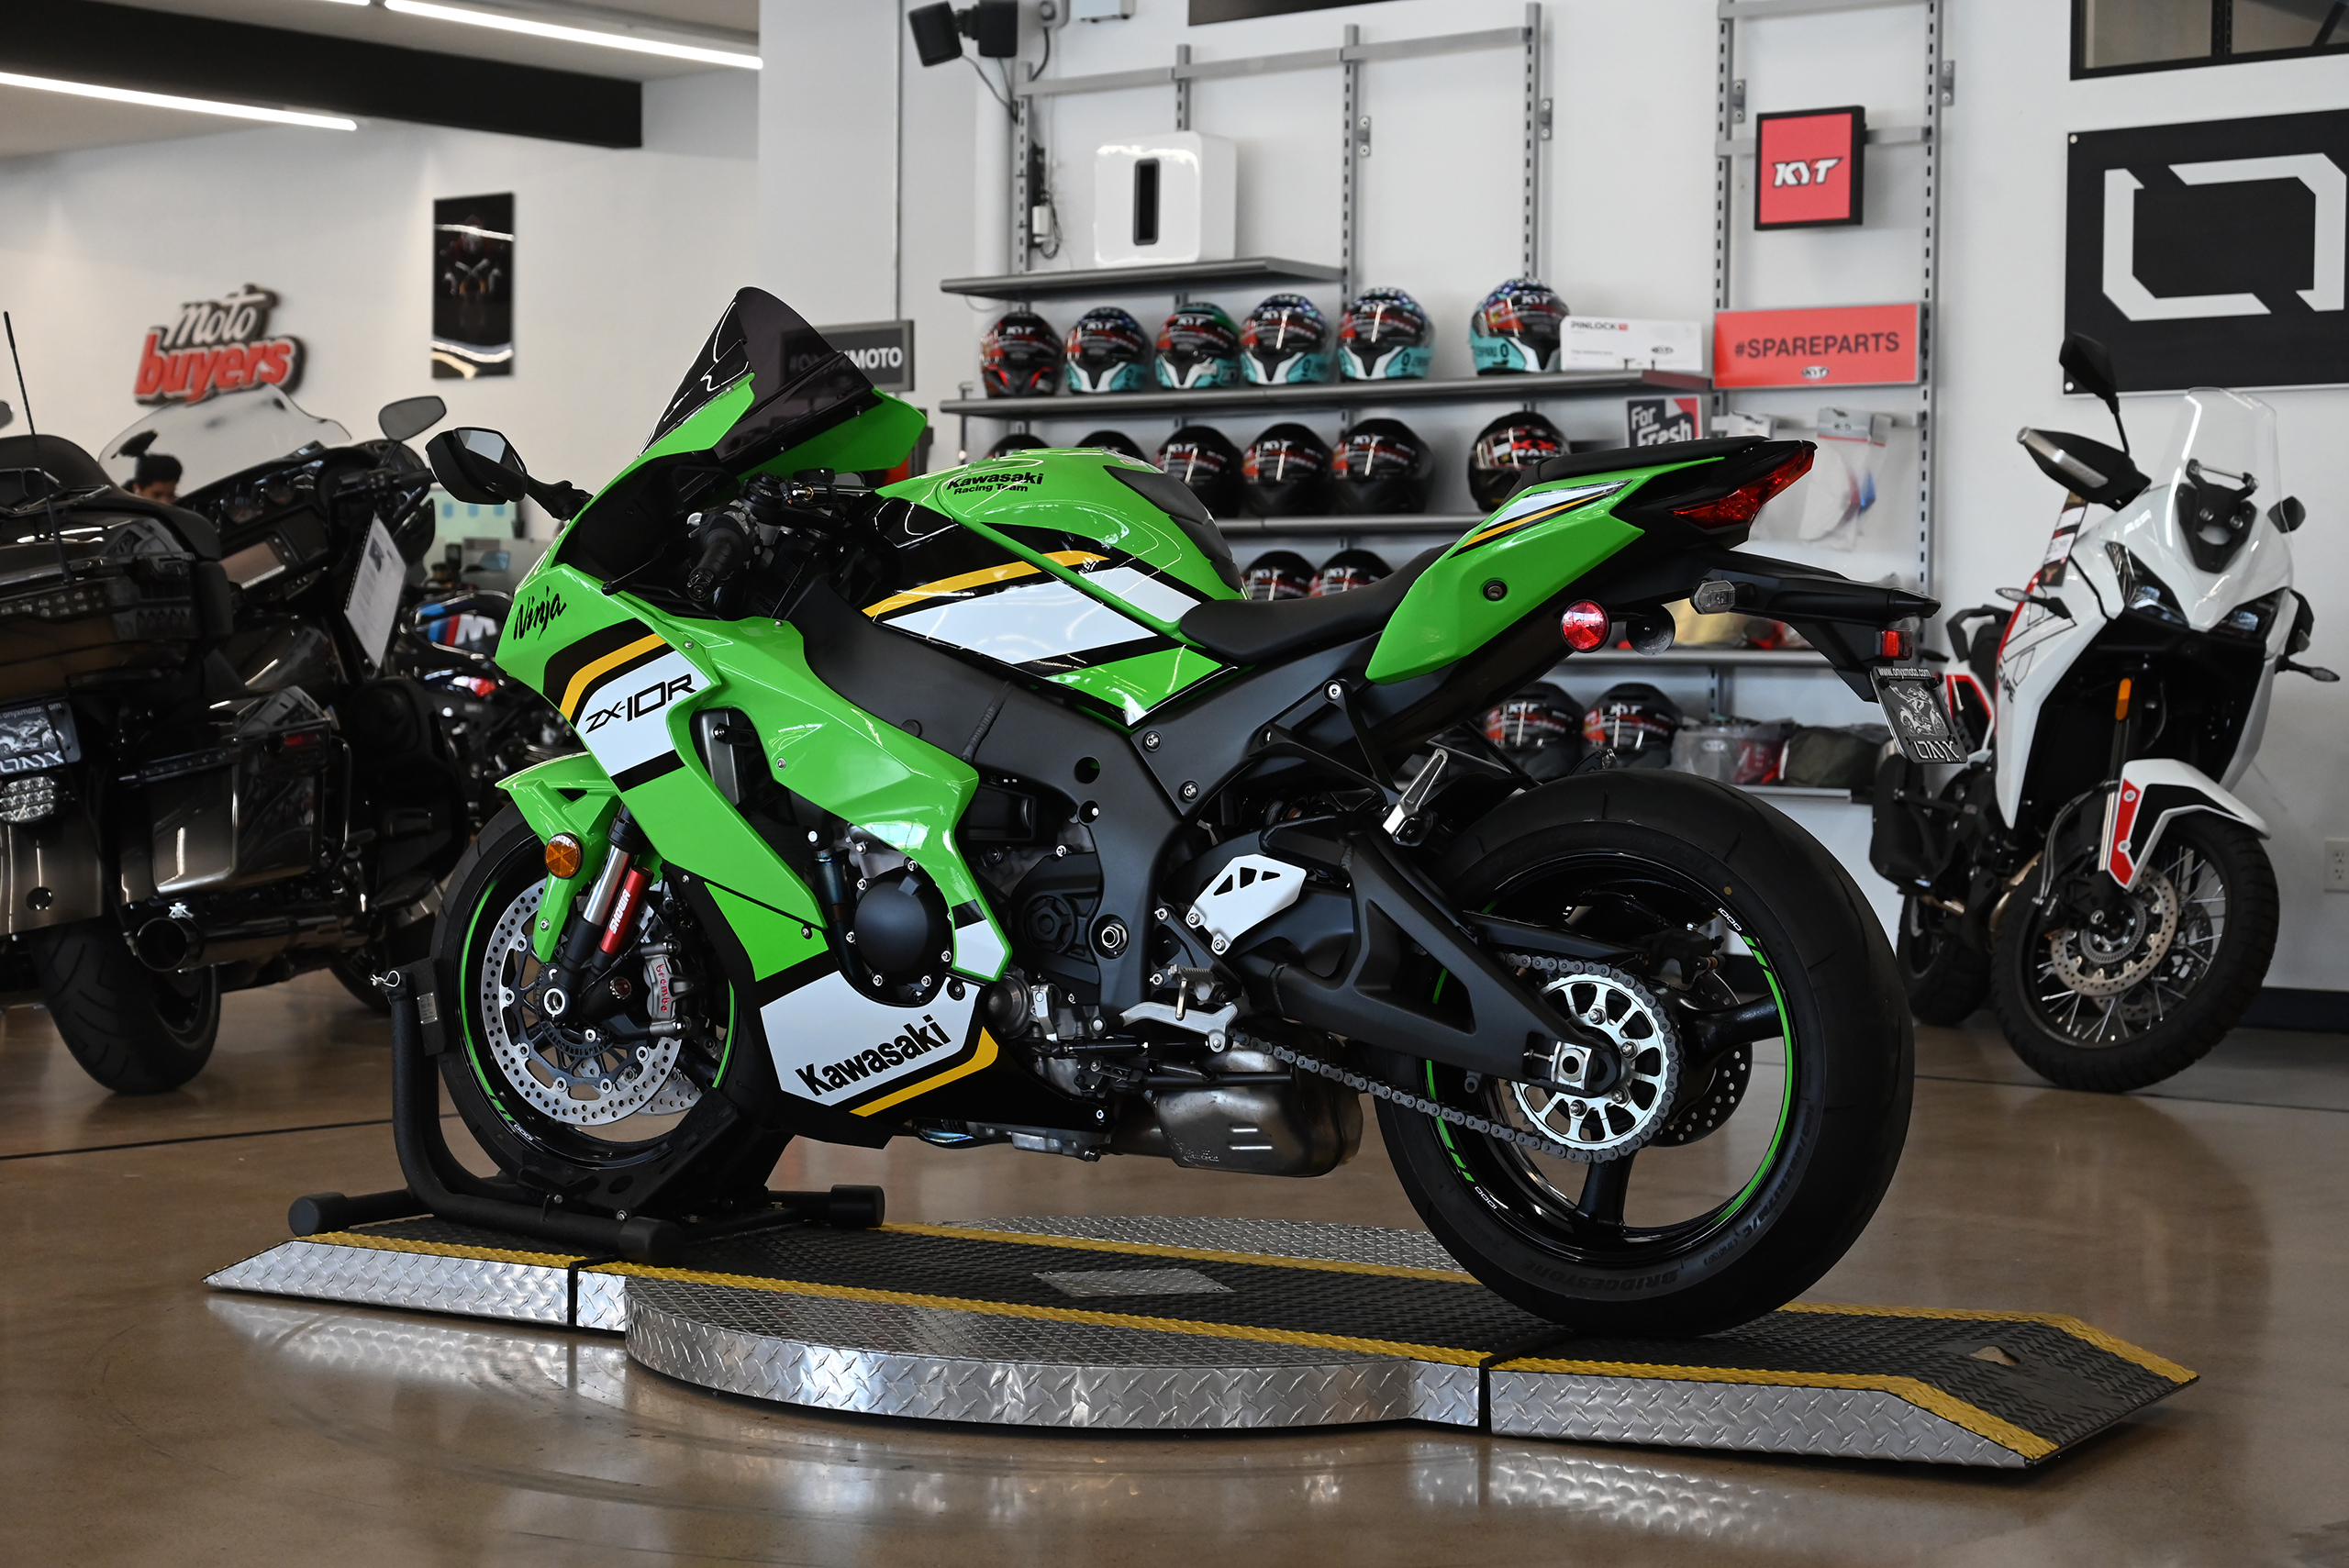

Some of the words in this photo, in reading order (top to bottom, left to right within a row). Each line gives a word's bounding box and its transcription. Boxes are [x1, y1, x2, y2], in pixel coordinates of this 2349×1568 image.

[1772, 157, 1843, 188] KYT
[1735, 332, 1899, 358] #SPAREPARTS
[134, 330, 294, 402] buyers
[1631, 406, 1656, 430] For
[947, 472, 1044, 490] Kawasaki
[953, 484, 993, 495] Racing
[996, 483, 1029, 492] Team
[513, 585, 567, 640] Ninja
[585, 673, 697, 734] ZX-10R
[609, 888, 631, 934] SHOWA
[1718, 907, 1742, 931] 1000
[656, 964, 672, 1012] brembo
[795, 1014, 952, 1096] Kawasaki
[514, 1124, 533, 1140] 1000
[1475, 1186, 1497, 1209] 1000
